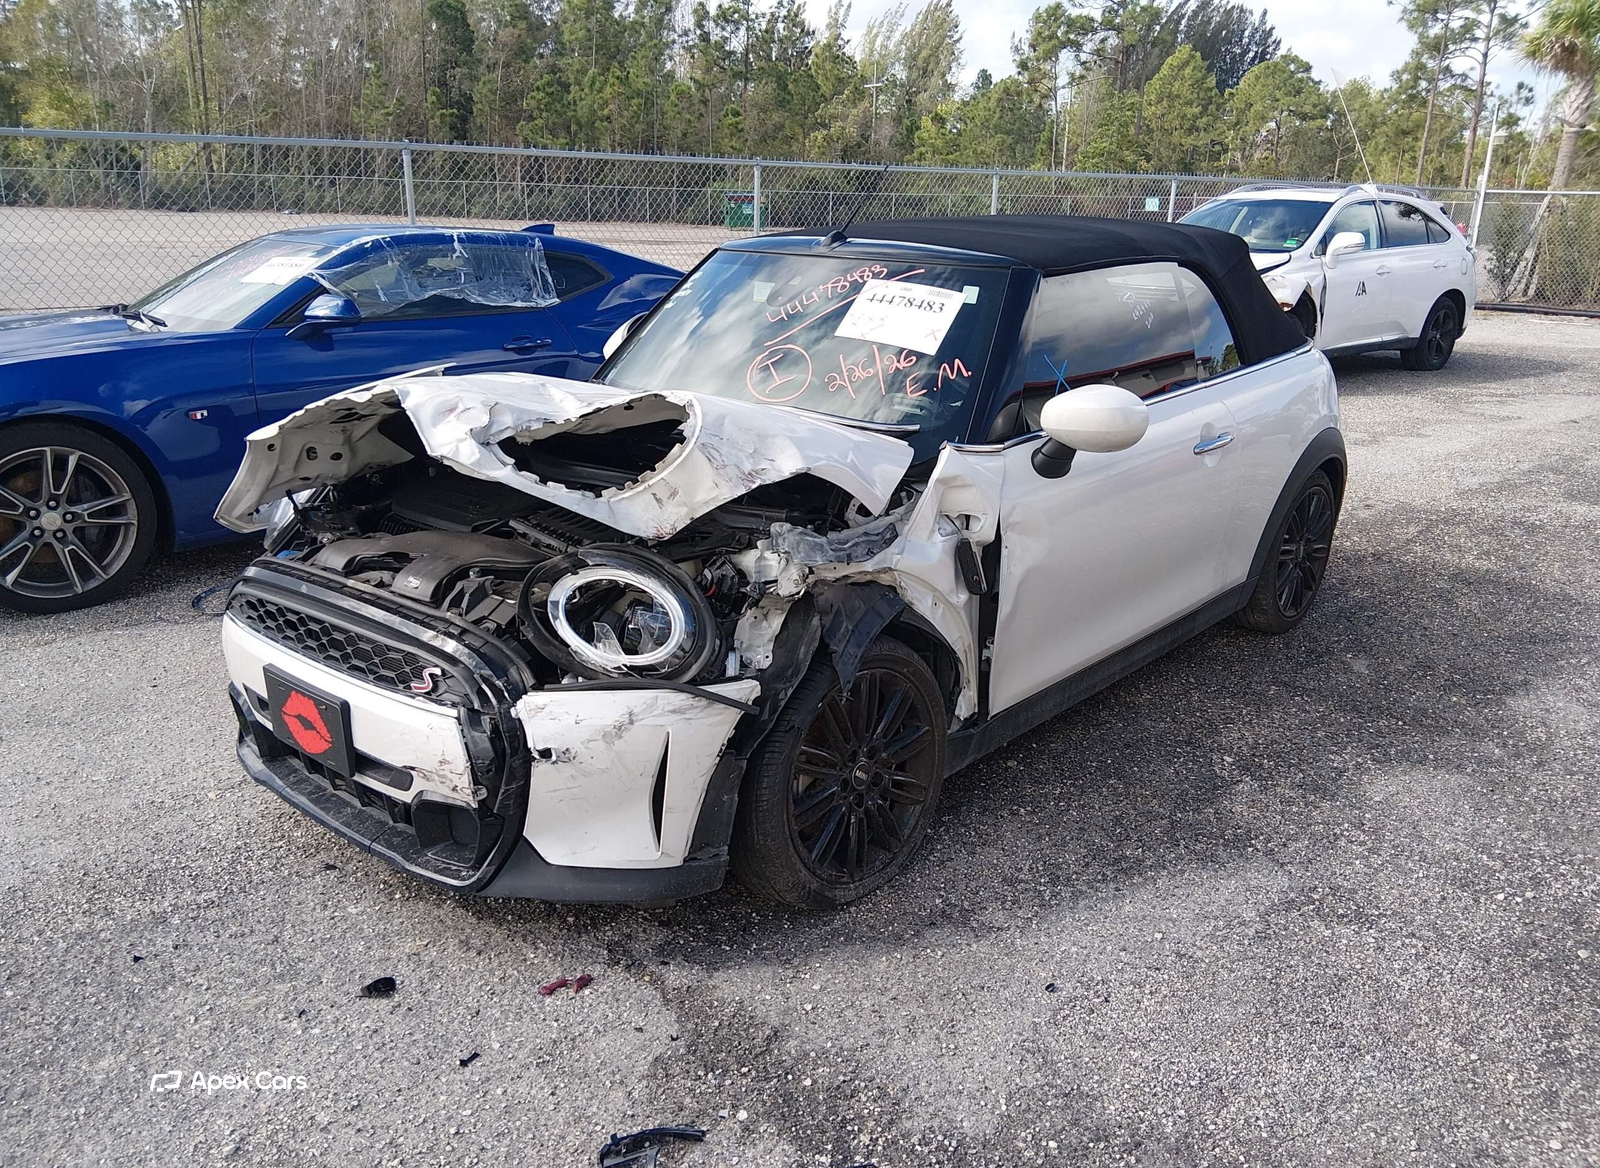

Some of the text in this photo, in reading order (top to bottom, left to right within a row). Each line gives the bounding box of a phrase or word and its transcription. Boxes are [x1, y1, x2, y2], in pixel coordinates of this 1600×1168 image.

[766, 264, 888, 323] 44478483
[866, 293, 945, 314] 44478483
[825, 345, 917, 399] 2/26/26
[410, 667, 442, 693] S
